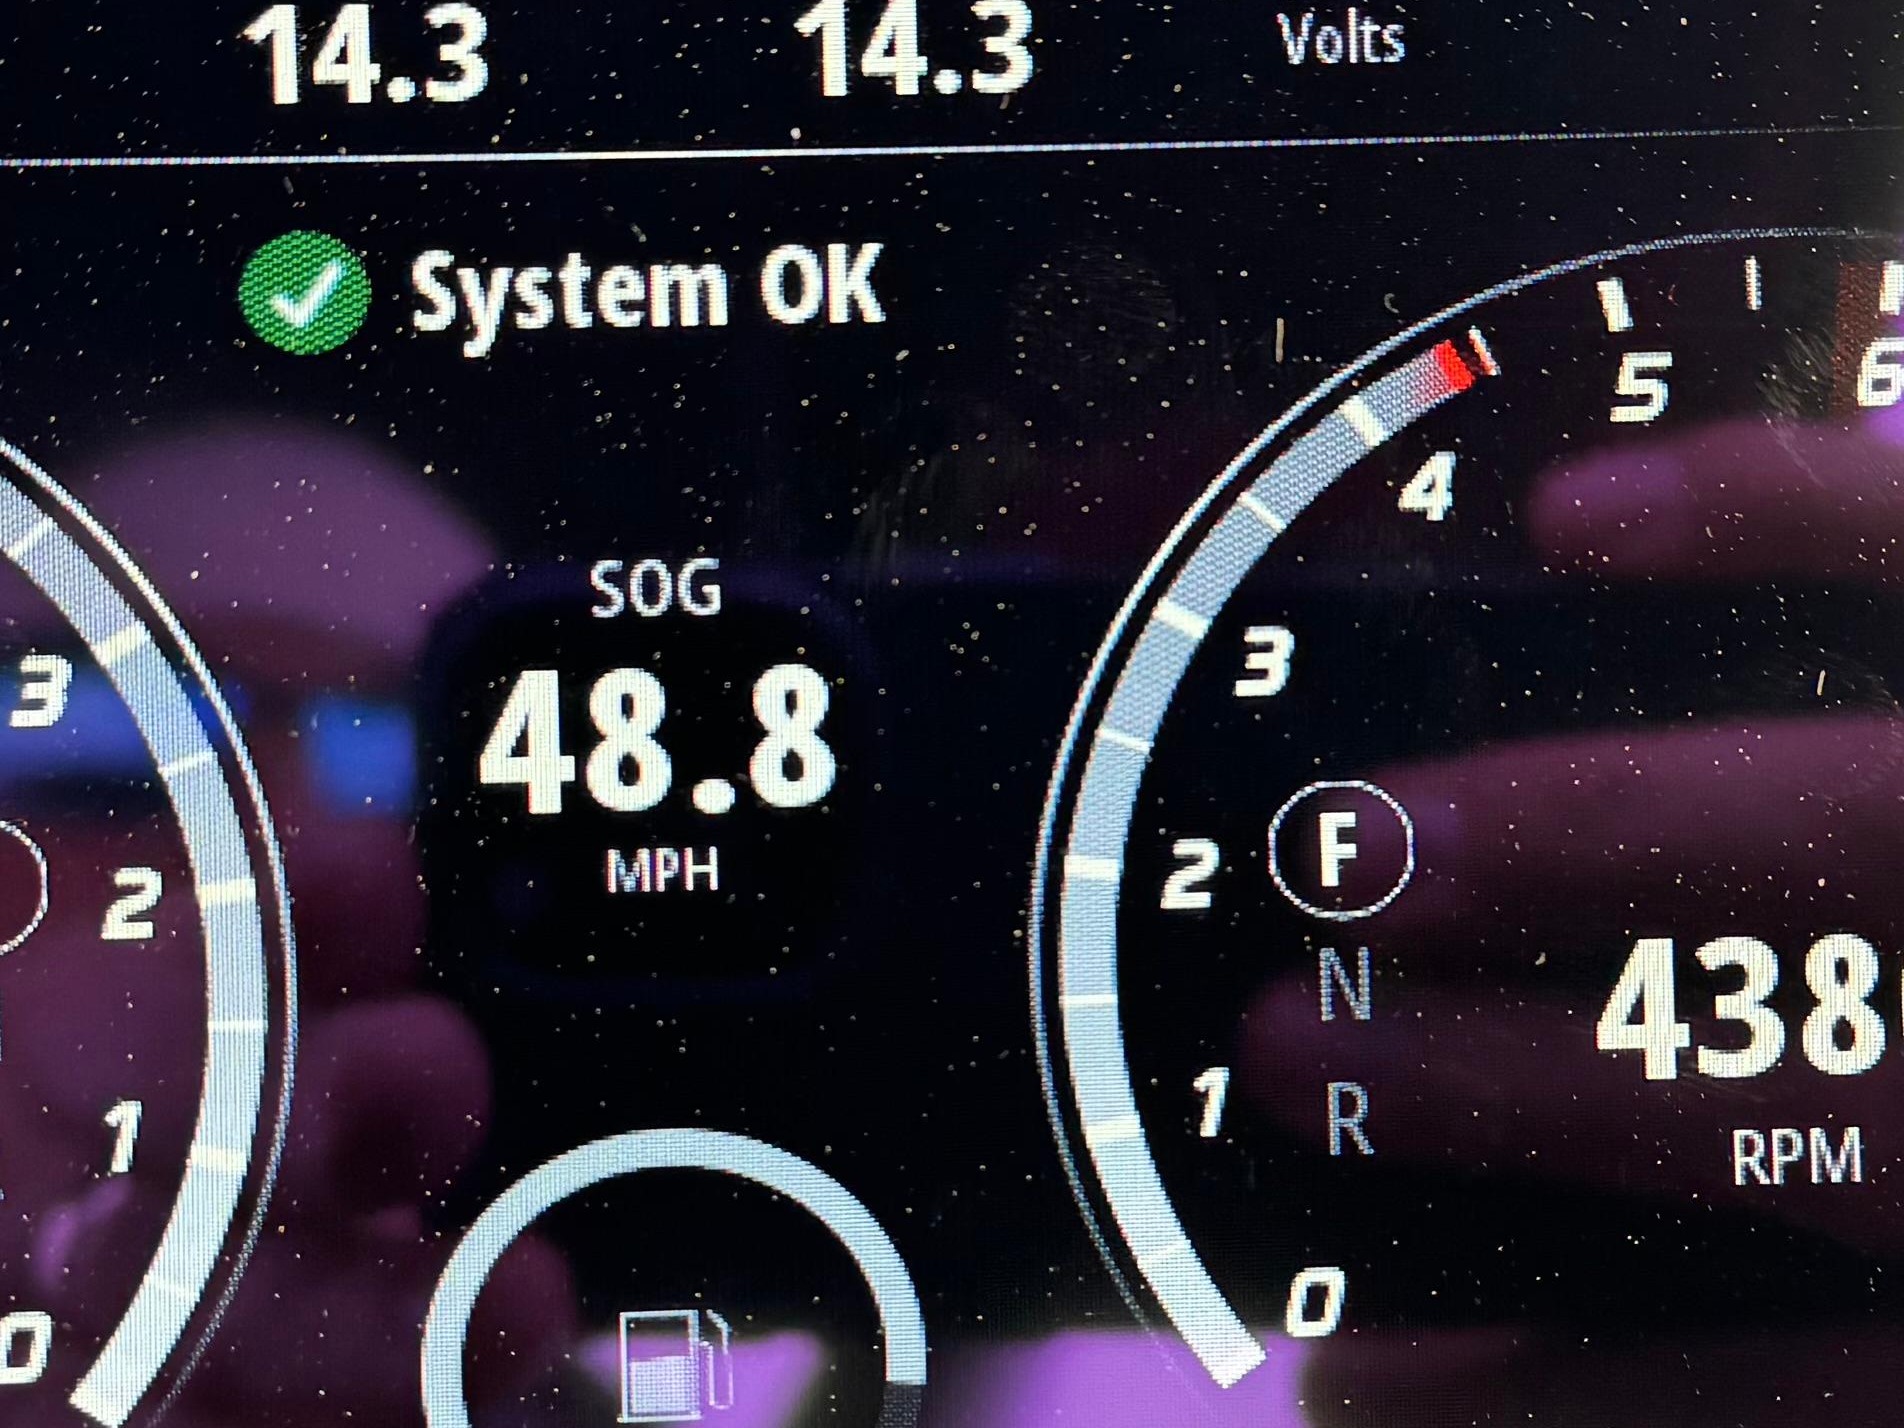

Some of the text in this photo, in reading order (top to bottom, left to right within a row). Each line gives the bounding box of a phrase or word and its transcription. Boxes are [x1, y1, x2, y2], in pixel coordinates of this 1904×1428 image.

[244, 1, 491, 106] 14.3
[1277, 6, 1405, 65] Volts
[410, 242, 887, 362] System OK
[1609, 350, 1673, 423] 5
[1398, 452, 1457, 521] 4
[588, 557, 724, 620] SOG
[8, 653, 74, 727] 3
[1234, 625, 1294, 697] 3
[478, 663, 840, 817] 48.8
[605, 846, 721, 894] MPH
[1159, 838, 1214, 909] 2
[1317, 812, 1360, 887] F
[99, 867, 163, 939] 2
[1318, 946, 1372, 1023] N
[101, 1101, 144, 1174] 1
[1193, 1067, 1230, 1137] 1
[1326, 1082, 1376, 1156] R
[1733, 1126, 1864, 1187] RPM
[1285, 1268, 1347, 1337] 0
